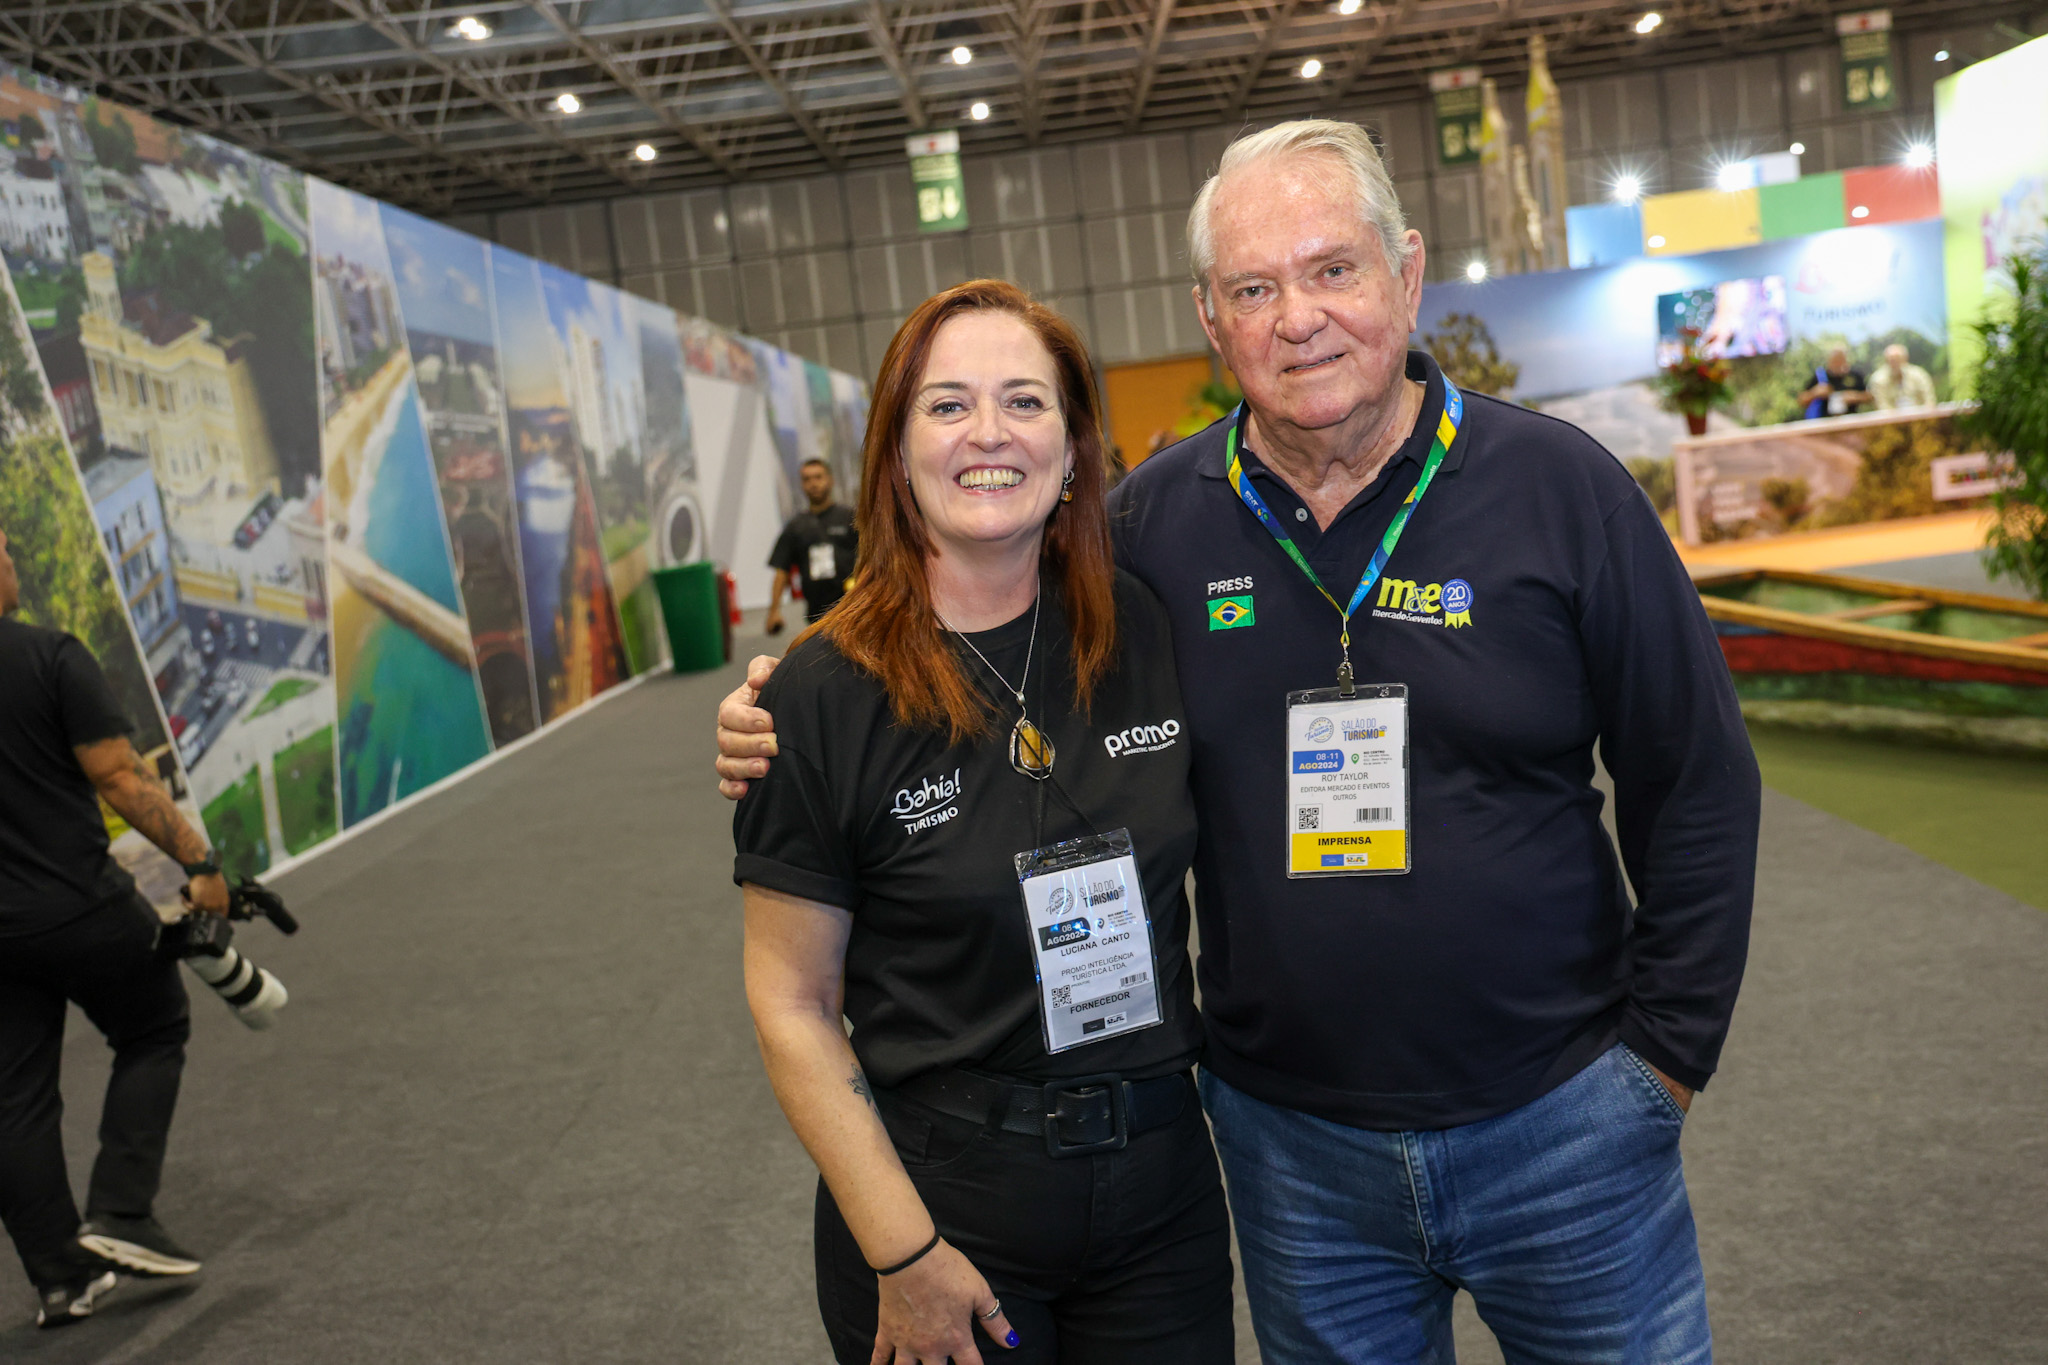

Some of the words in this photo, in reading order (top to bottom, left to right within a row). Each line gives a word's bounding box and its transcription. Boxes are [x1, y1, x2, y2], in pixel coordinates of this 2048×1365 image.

[1207, 576, 1254, 595] PRESS
[1446, 586, 1466, 601] 20
[1341, 717, 1365, 730] SALÃO
[1366, 717, 1376, 728] DO
[1104, 719, 1180, 758] promo
[1343, 728, 1379, 741] TURISMO
[1299, 761, 1339, 770] AGO2024
[1321, 774, 1338, 782] ROY
[1339, 772, 1369, 781] TAYLOR
[890, 768, 961, 814] Bahia!
[1327, 784, 1356, 792] MERCADO
[1362, 782, 1390, 790] EVENTOS
[1332, 793, 1357, 801] OUTROS
[904, 806, 959, 836] TURISMO
[1318, 836, 1372, 846] IMPRENSA
[1104, 879, 1115, 890] DO
[1083, 889, 1119, 908] TURISMO
[1047, 930, 1086, 946] AGO2024
[1060, 941, 1098, 957] LUCIANA
[1101, 932, 1130, 946] CANTO
[1061, 964, 1087, 977] PROMO
[1087, 952, 1134, 970] INTELIGÊNCIA
[1071, 967, 1107, 982] TURÍSTICA
[1070, 991, 1131, 1014] FORNECEDOR
